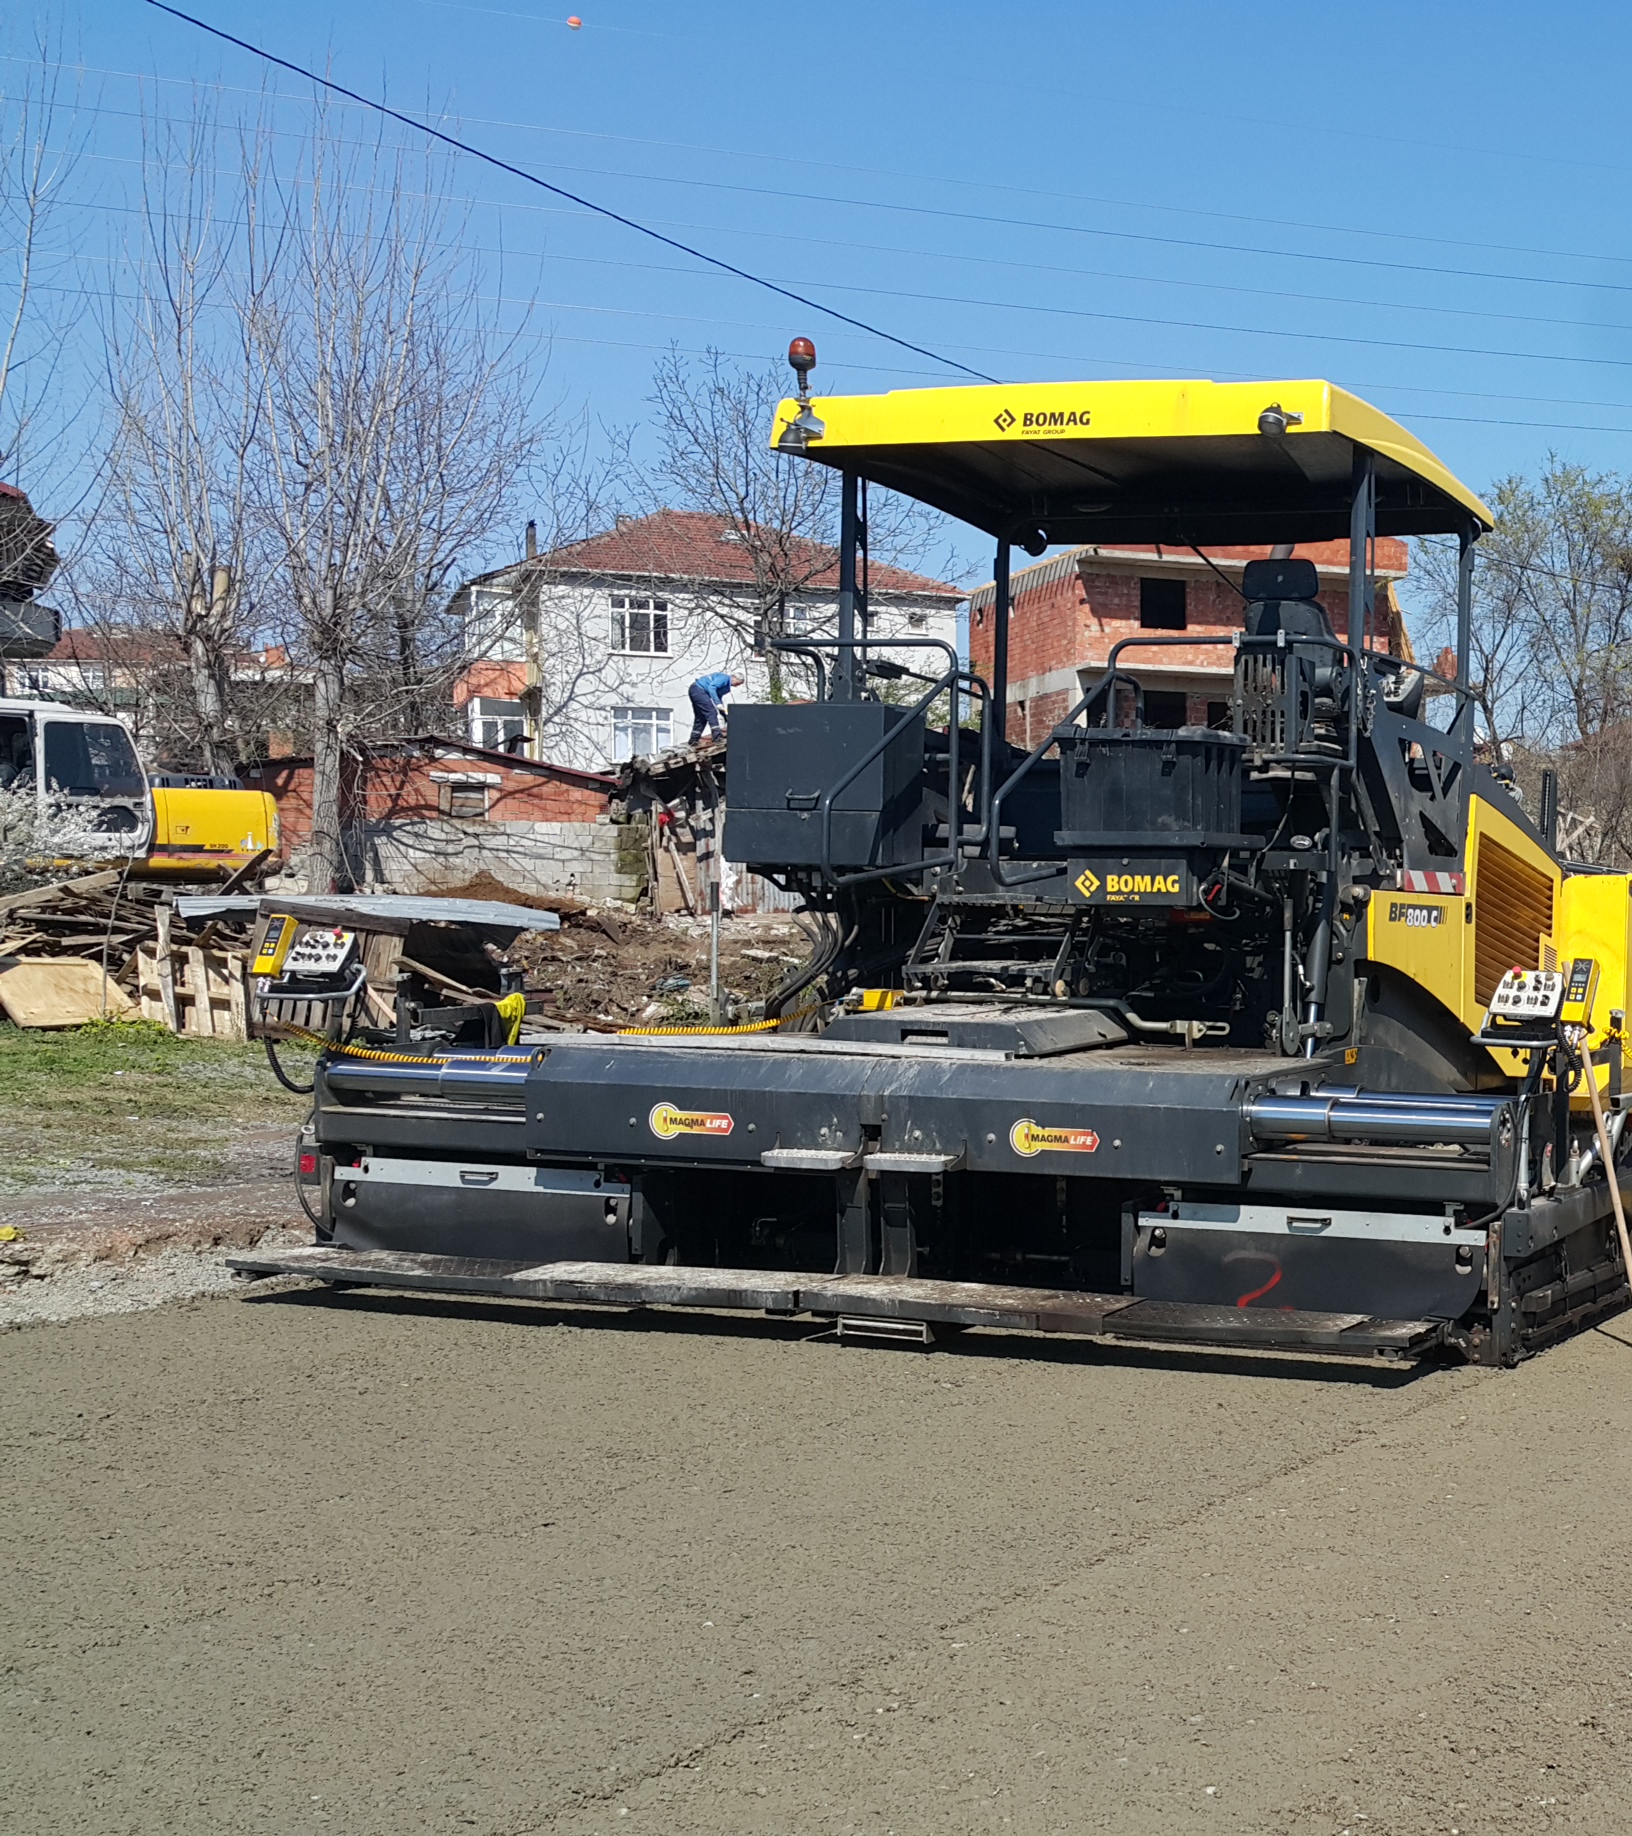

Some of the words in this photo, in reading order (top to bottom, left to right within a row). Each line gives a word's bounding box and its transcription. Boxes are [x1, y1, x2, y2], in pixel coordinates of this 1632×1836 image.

[1022, 411, 1091, 427] BOMAG
[1106, 875, 1179, 893] BOMAG
[1406, 908, 1428, 927] 800
[1430, 910, 1438, 928] C
[669, 1117, 705, 1127] MAGMA
[705, 1119, 729, 1128] LIFE
[1031, 1134, 1070, 1144] MAGMA
[1070, 1135, 1094, 1145] LIFE
